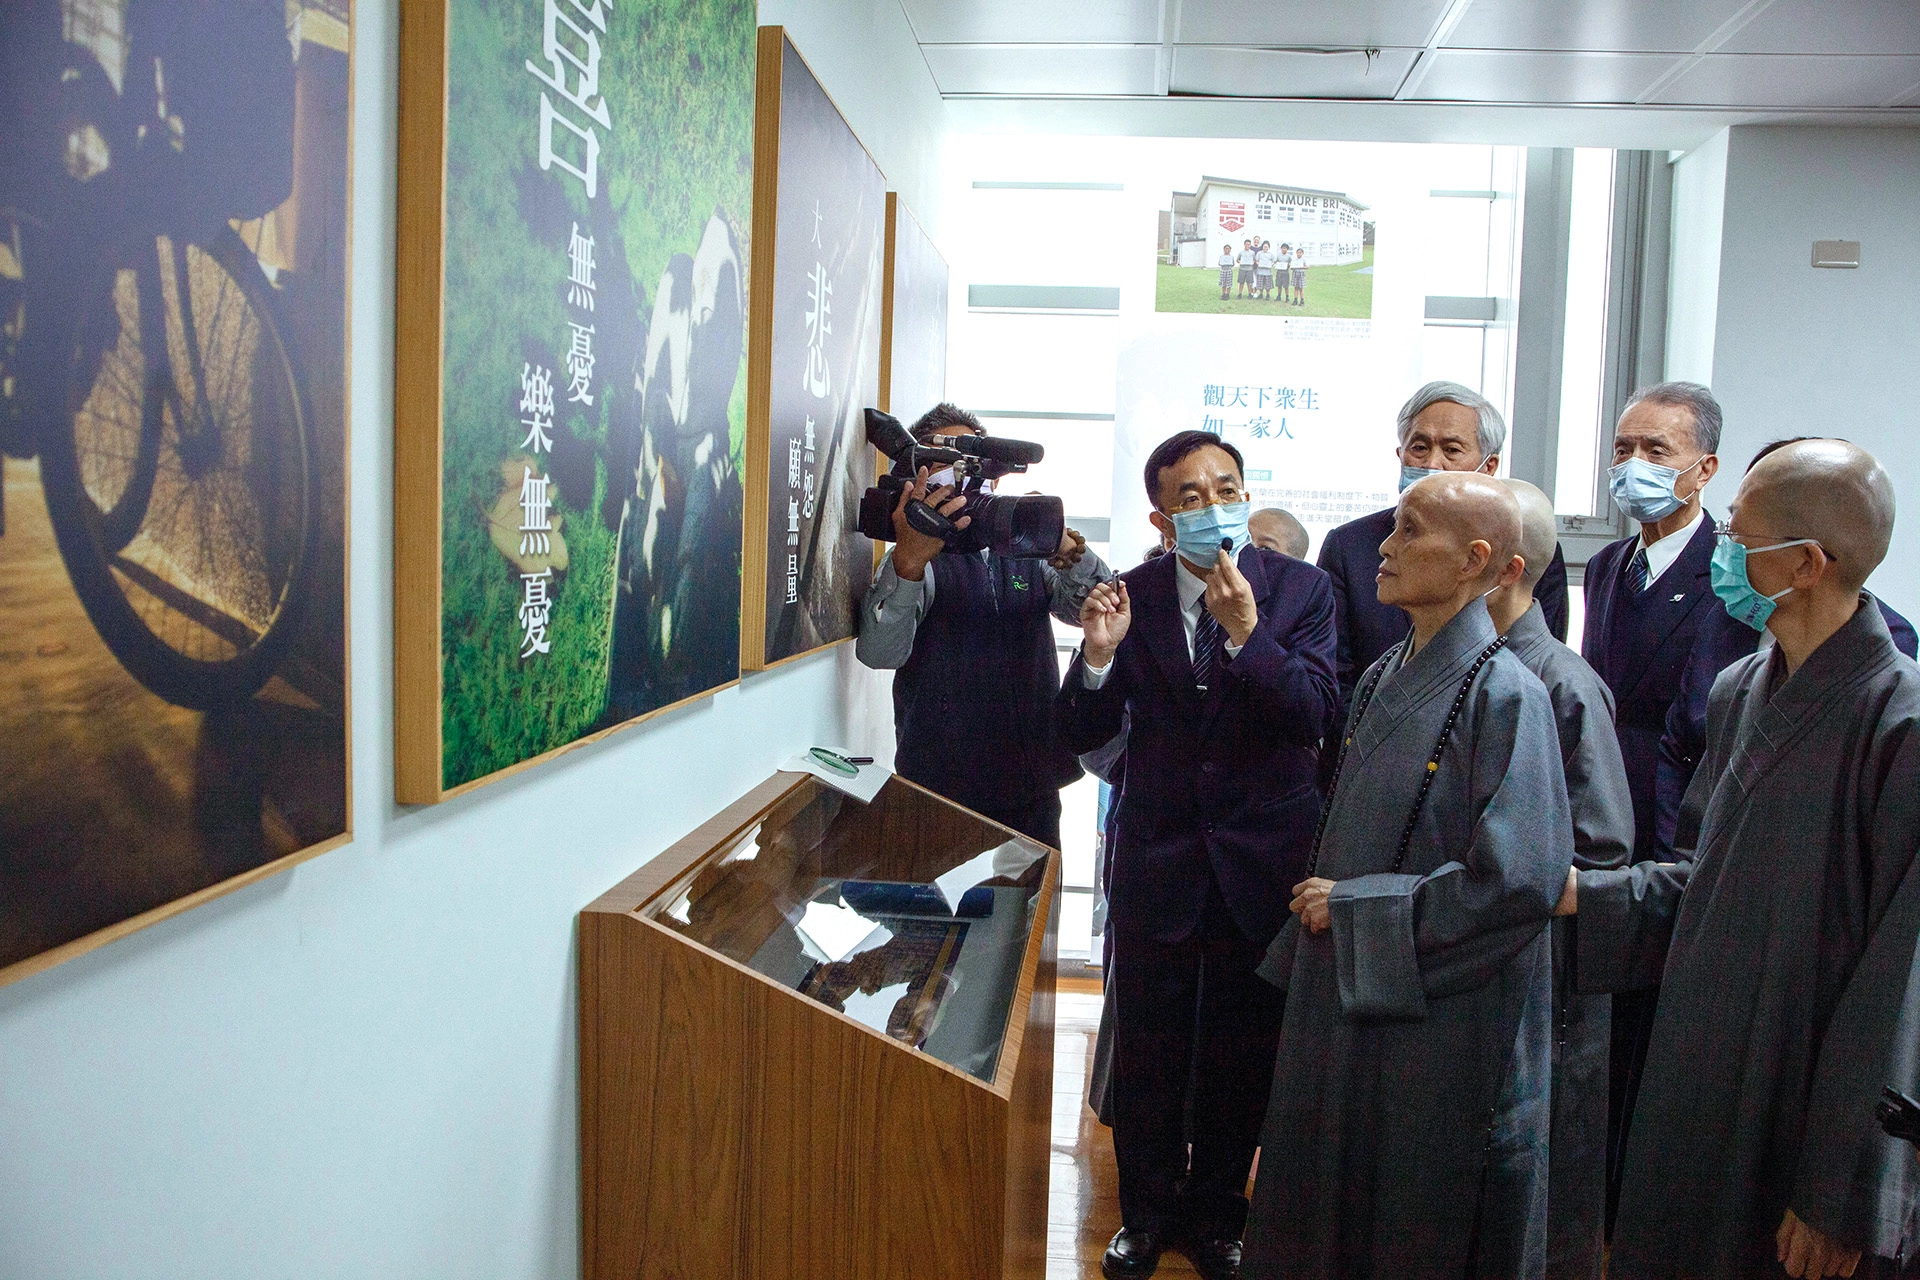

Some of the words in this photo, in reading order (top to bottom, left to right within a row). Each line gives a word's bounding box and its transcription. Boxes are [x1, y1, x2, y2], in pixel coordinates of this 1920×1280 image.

[1258, 191, 1317, 207] PANMURE
[566, 221, 596, 406] 無憂
[1202, 414, 1294, 439] 如一家人
[519, 362, 554, 658] 樂無憂
